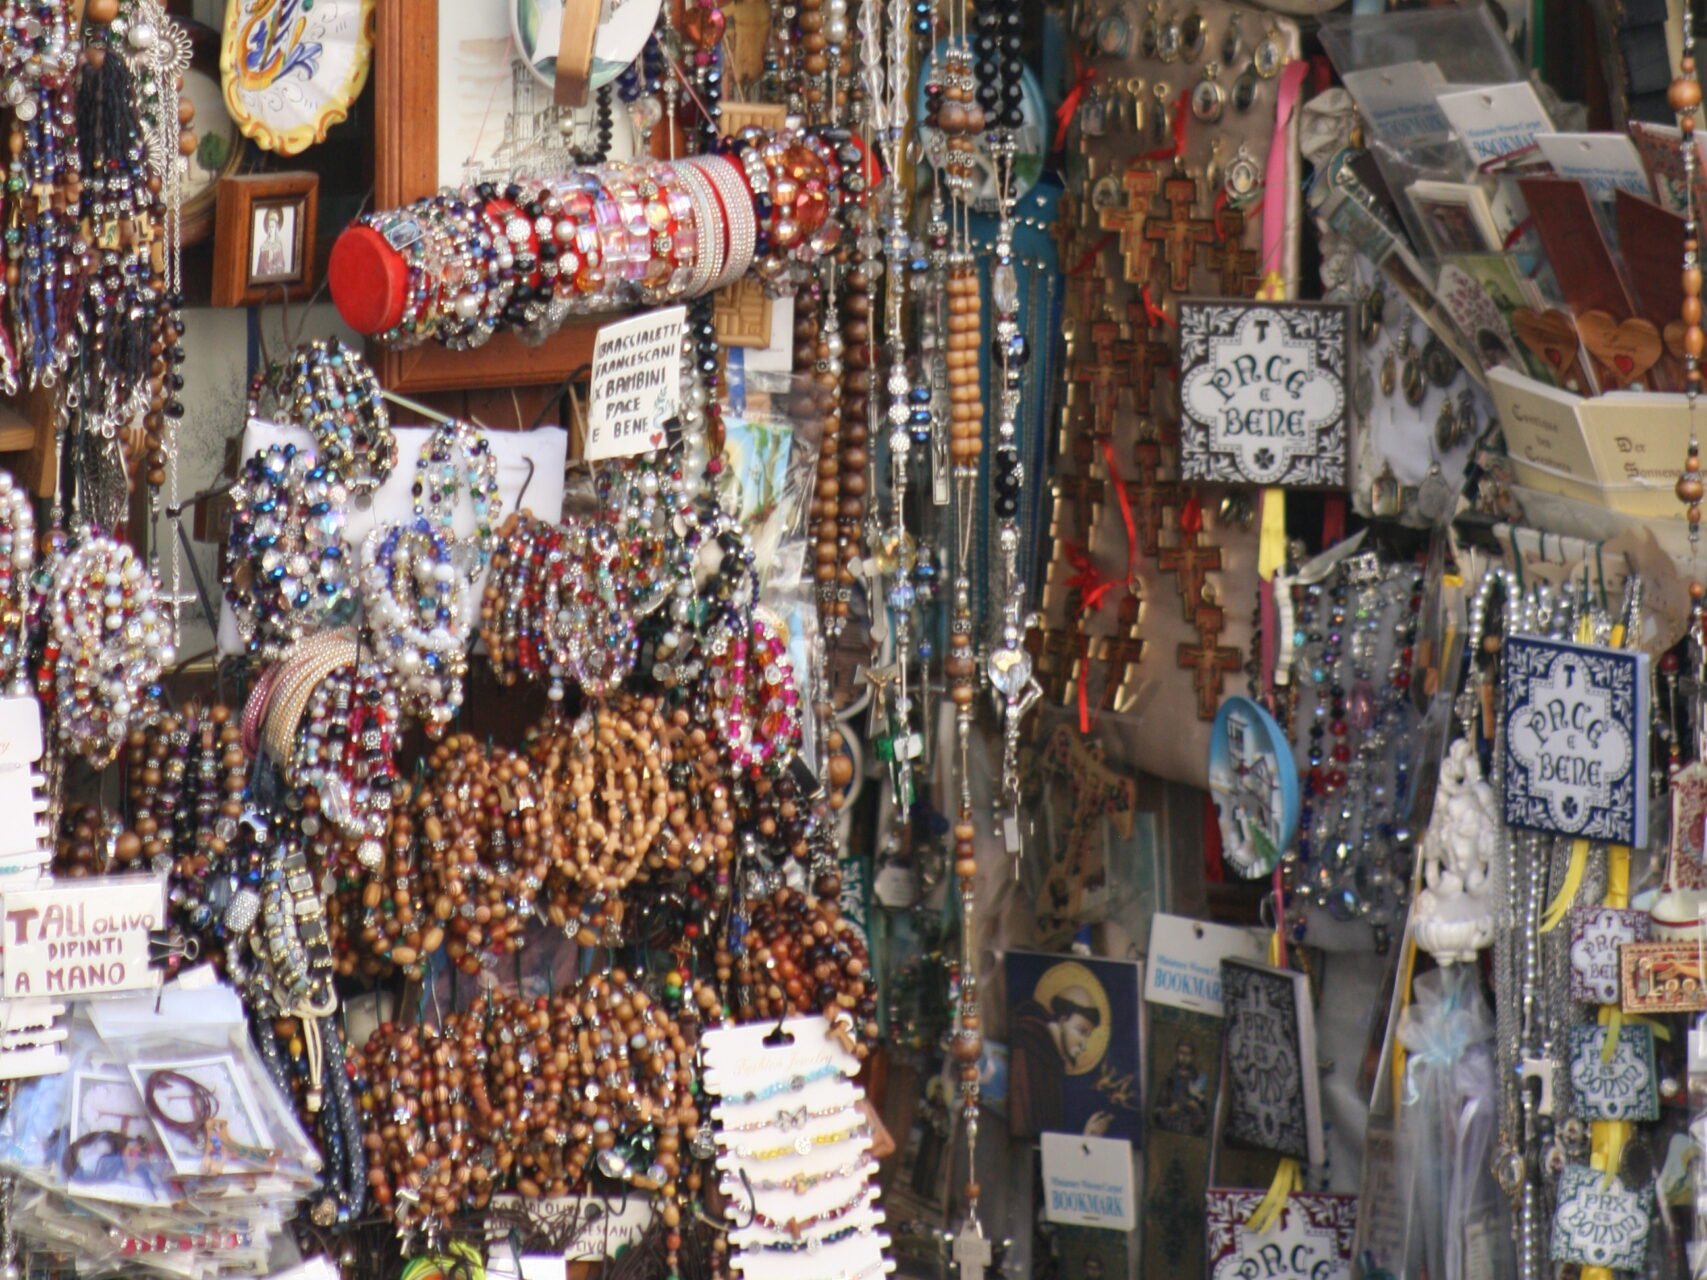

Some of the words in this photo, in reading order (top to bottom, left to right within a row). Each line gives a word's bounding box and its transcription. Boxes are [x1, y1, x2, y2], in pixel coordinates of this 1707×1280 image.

[598, 322, 682, 359] BRACCIALETTI
[594, 344, 675, 380] FRANCESCANI
[605, 367, 665, 399] BAMBINI
[1204, 354, 1314, 404] PACE
[1260, 388, 1271, 402] E
[606, 397, 640, 420] PACE
[1219, 407, 1306, 437] BENE
[592, 428, 600, 442] E
[614, 417, 648, 439] BENE
[1525, 698, 1609, 749] PACE
[1536, 752, 1602, 788] BENE
[5, 902, 85, 945] TAU
[92, 914, 156, 935] OLIVO
[47, 937, 123, 961] DIPINTI
[1583, 934, 1622, 959] PAC
[15, 972, 31, 993] A
[46, 962, 126, 992] MANO
[1154, 967, 1222, 1003] BOOKMAR
[1052, 1190, 1124, 1217] BOOKMARK
[1232, 1243, 1338, 1280] PACE
